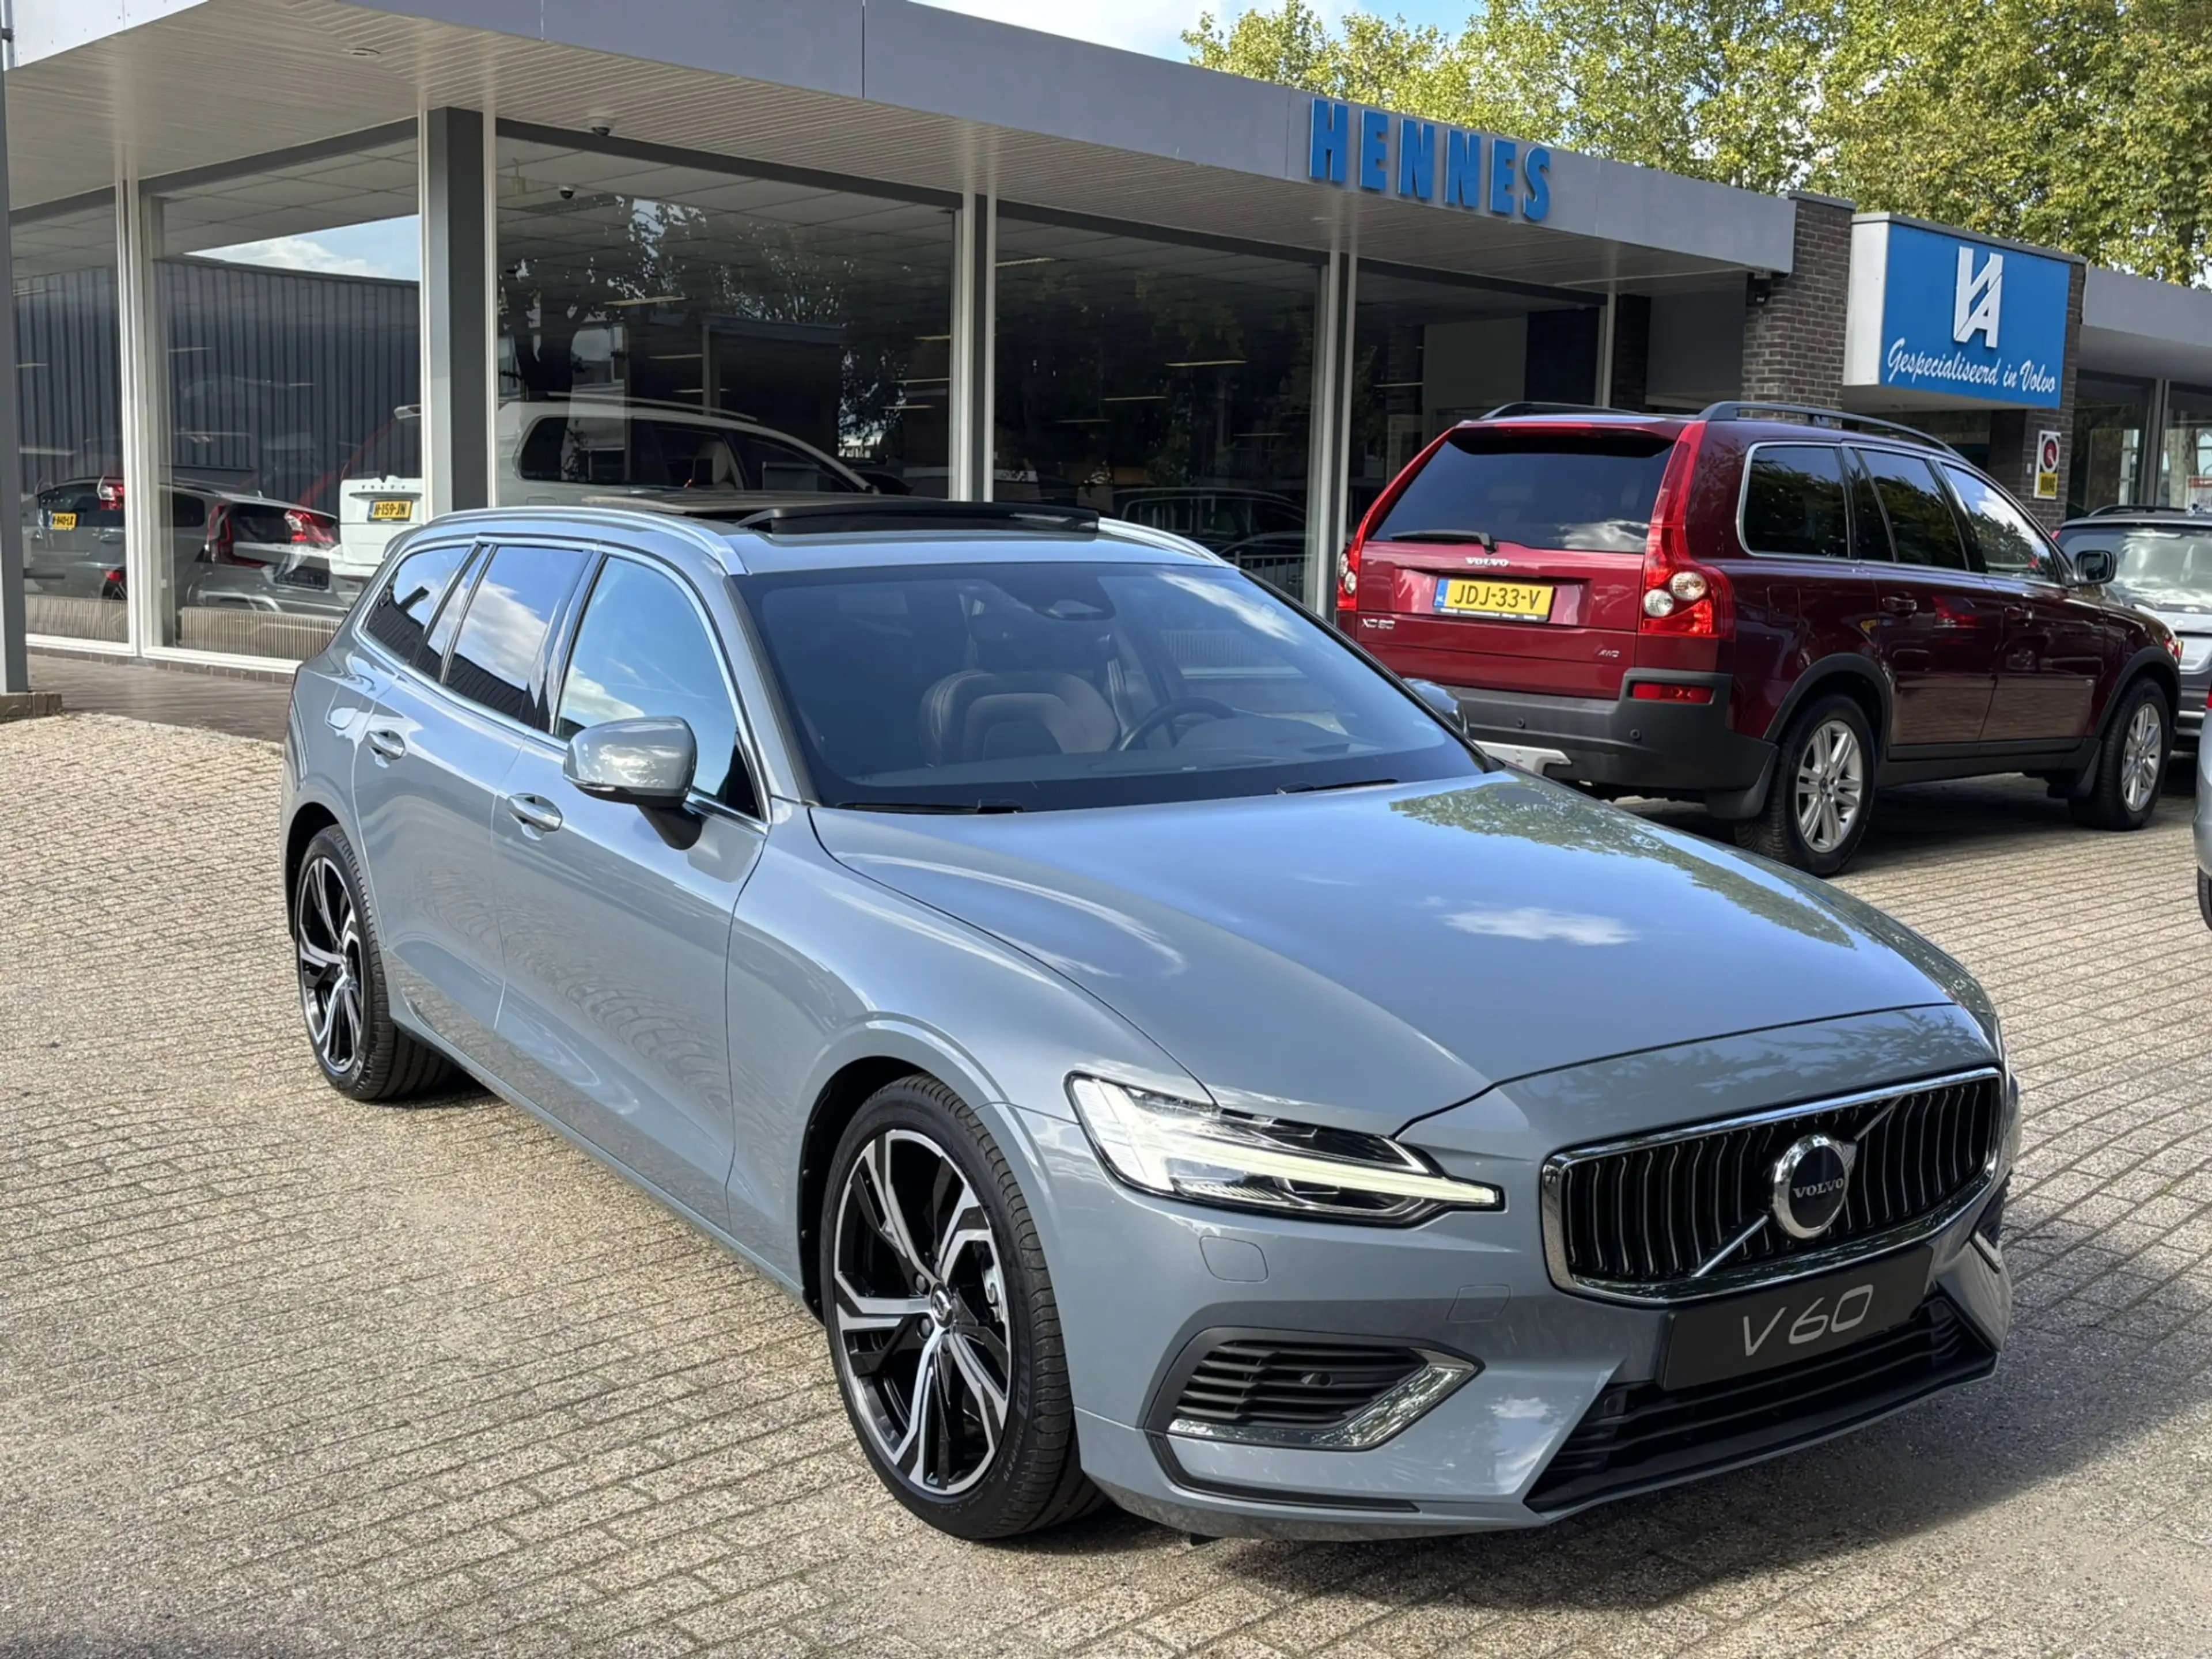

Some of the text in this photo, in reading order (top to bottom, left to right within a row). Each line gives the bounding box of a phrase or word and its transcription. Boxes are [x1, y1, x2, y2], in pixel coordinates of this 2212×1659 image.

[1309, 97, 1551, 222] HENNES
[1887, 338, 2056, 393] Gespecialiseerd in Volvo
[1465, 556, 1510, 567] VOLVO
[1453, 584, 1541, 611] JDJ-33-V
[1792, 1177, 1844, 1198] VOLVO
